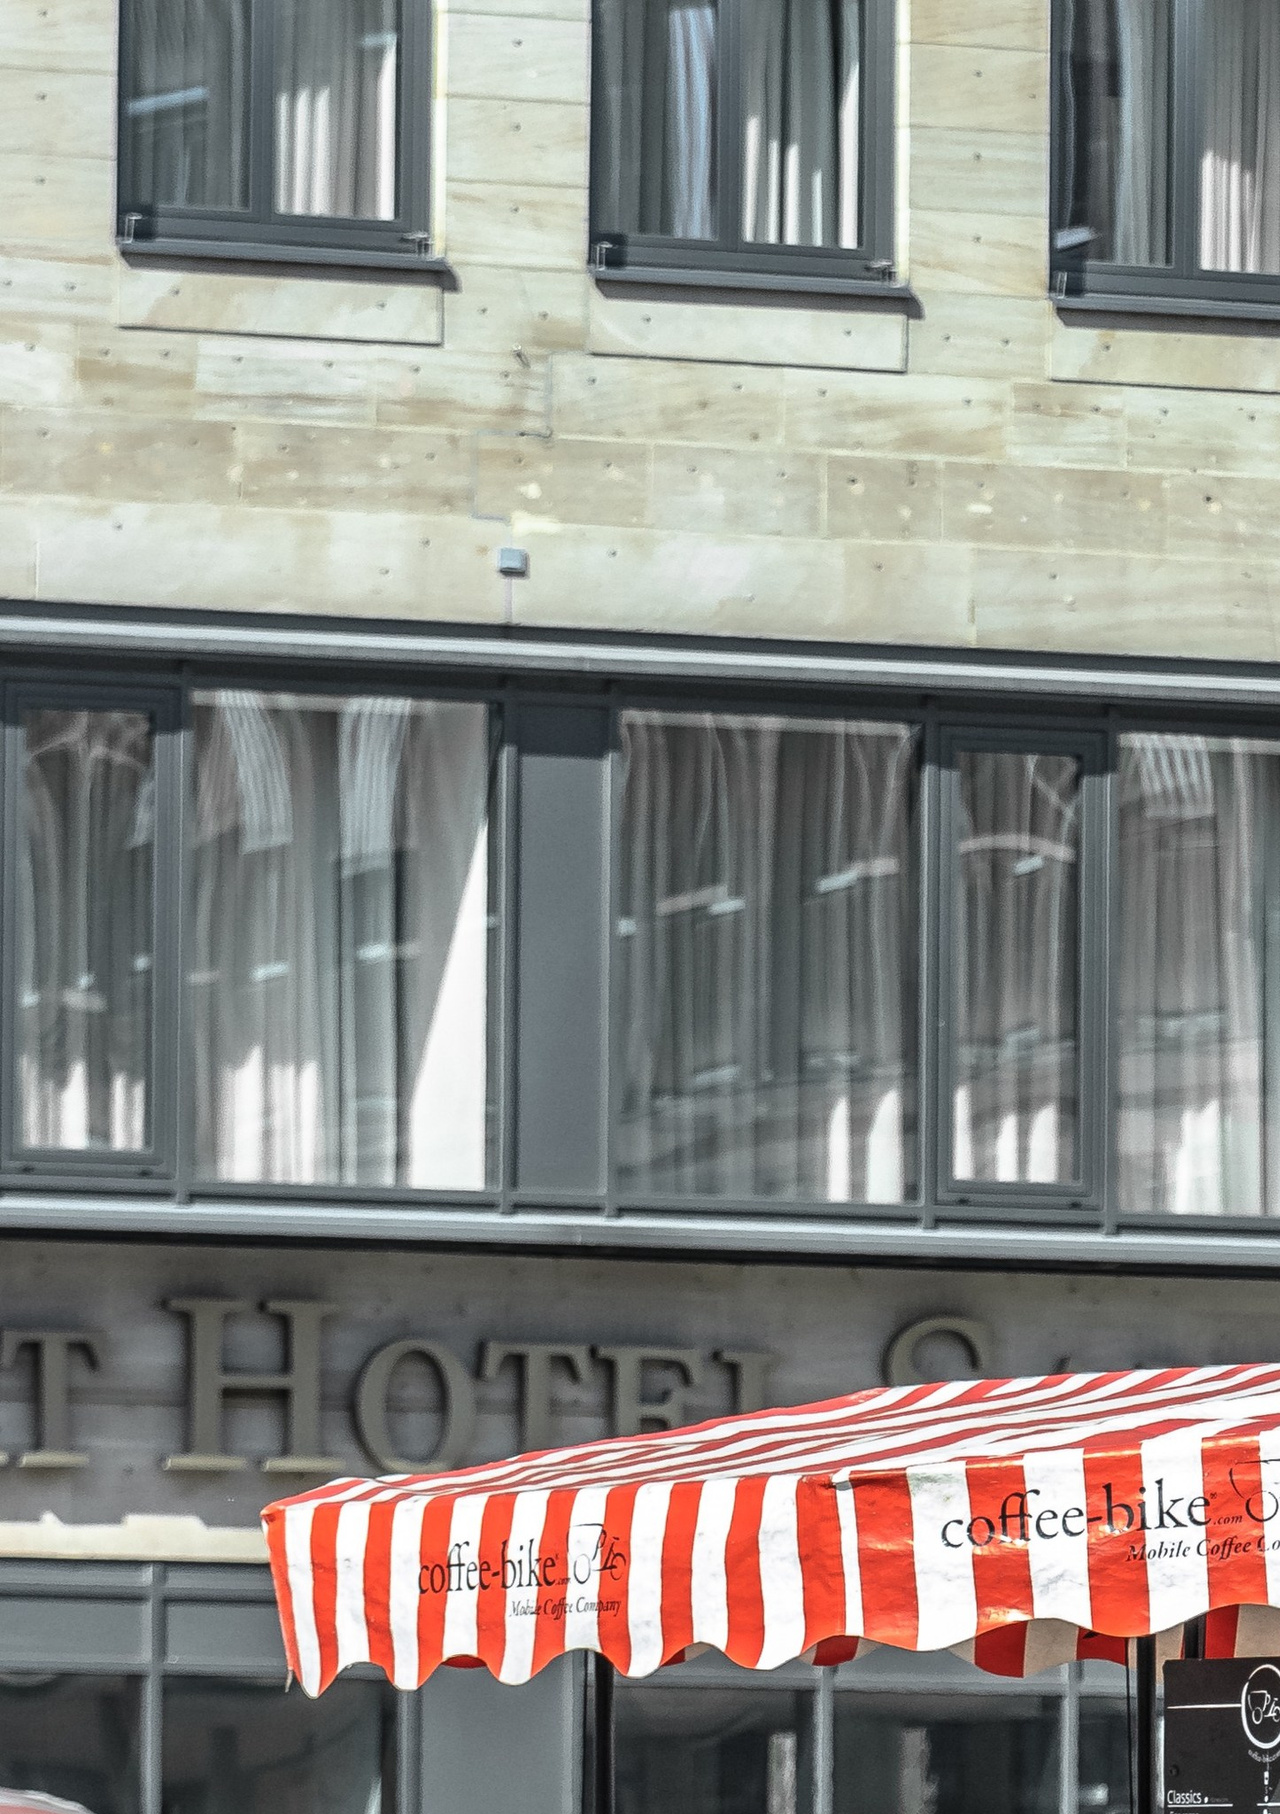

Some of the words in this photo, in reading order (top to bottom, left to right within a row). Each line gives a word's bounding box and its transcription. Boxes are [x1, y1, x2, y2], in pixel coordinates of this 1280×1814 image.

[1126, 1539, 1191, 1562] Mobile
[1196, 1535, 1252, 1561] Coffee
[543, 1598, 573, 1621] Coffee
[576, 1597, 622, 1617] Company
[1167, 1789, 1202, 1804] Classics
